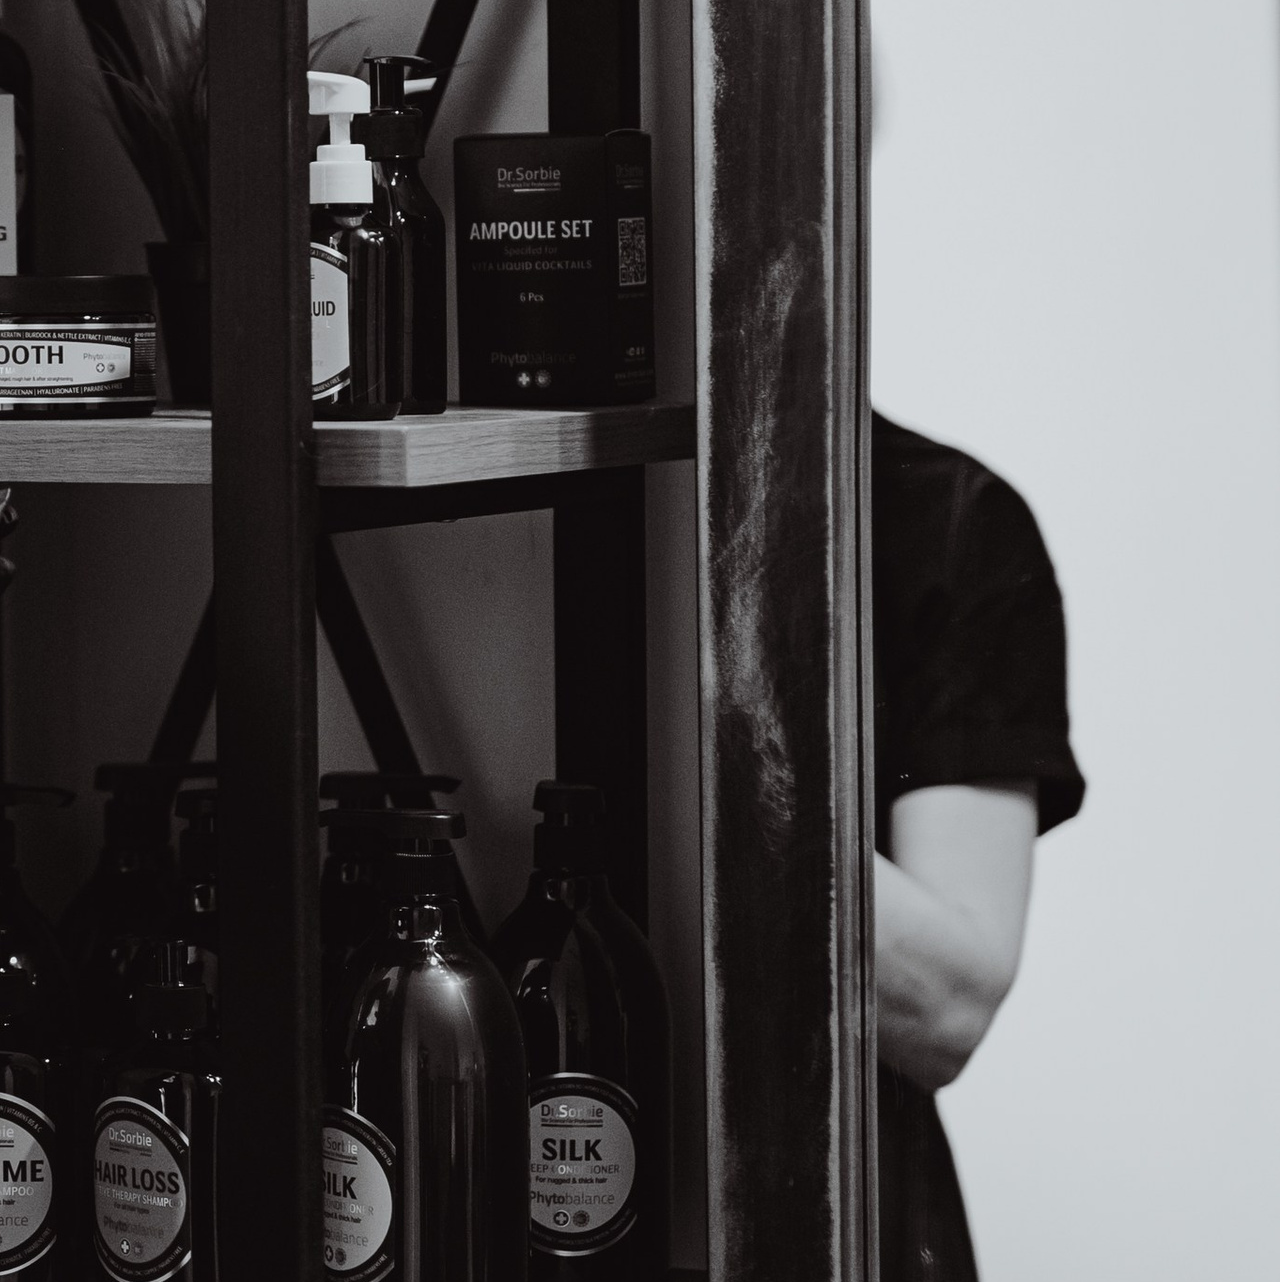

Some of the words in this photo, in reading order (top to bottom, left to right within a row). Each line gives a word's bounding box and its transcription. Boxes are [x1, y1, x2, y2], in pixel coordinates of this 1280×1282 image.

[497, 166, 561, 182] Dr.Sorbie
[469, 221, 557, 240] AMPOULE
[560, 220, 594, 238] SET
[544, 244, 558, 255] for
[471, 261, 495, 272] VITA
[496, 260, 533, 271] LIQUID
[534, 259, 593, 270] COCKTAILS
[519, 292, 527, 303] 6
[528, 292, 545, 302] Pcs
[311, 300, 336, 317] UID
[78, 333, 101, 341] EXTRACT
[490, 350, 577, 368] Phytobalance
[36, 387, 79, 395] HYALURONATE
[83, 384, 112, 392] PARABENS
[541, 1103, 604, 1119] Dr.Sorie
[108, 1127, 153, 1147] Dr.Sorbie
[542, 1138, 603, 1161] SILK
[94, 1159, 128, 1188] HAIR
[131, 1166, 180, 1194] LOSS
[530, 1163, 549, 1174] EEP
[535, 1175, 546, 1183] For
[571, 1176, 577, 1184] &
[111, 1188, 141, 1203] THERAPY
[530, 1190, 615, 1207] Phytobalance
